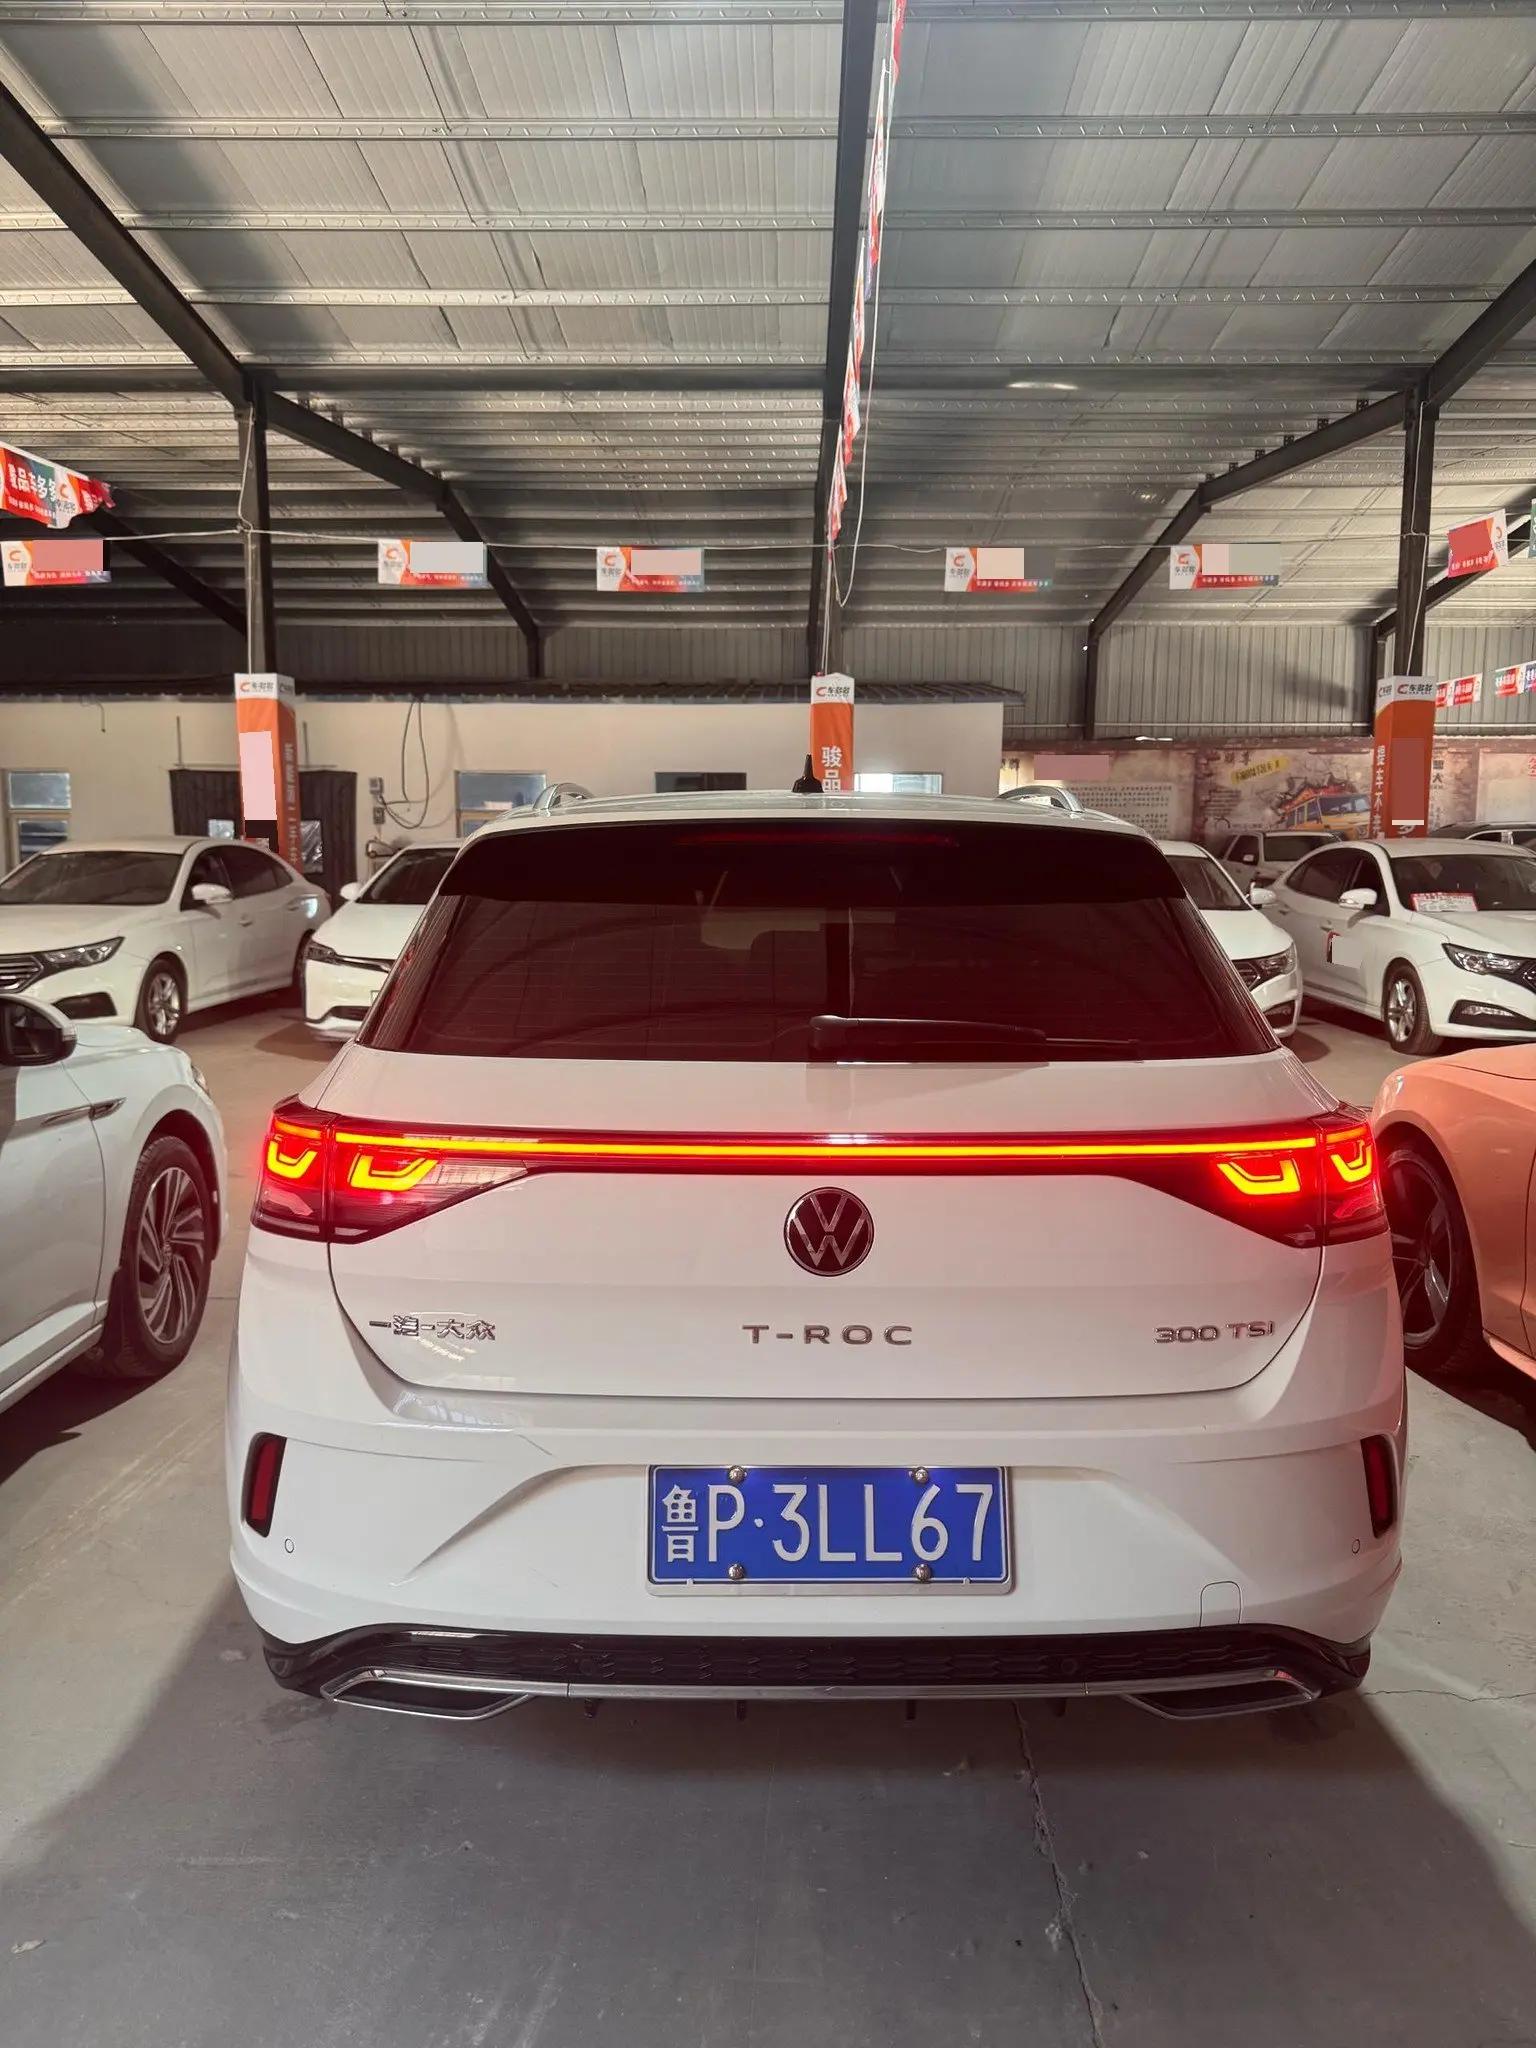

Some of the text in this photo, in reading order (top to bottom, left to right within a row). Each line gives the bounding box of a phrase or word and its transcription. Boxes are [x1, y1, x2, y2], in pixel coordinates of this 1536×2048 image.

[742, 1325, 912, 1345] T-ROC
[1154, 1320, 1273, 1343] 300 TSI
[661, 1483, 994, 1563] 鲁P·3LL67
